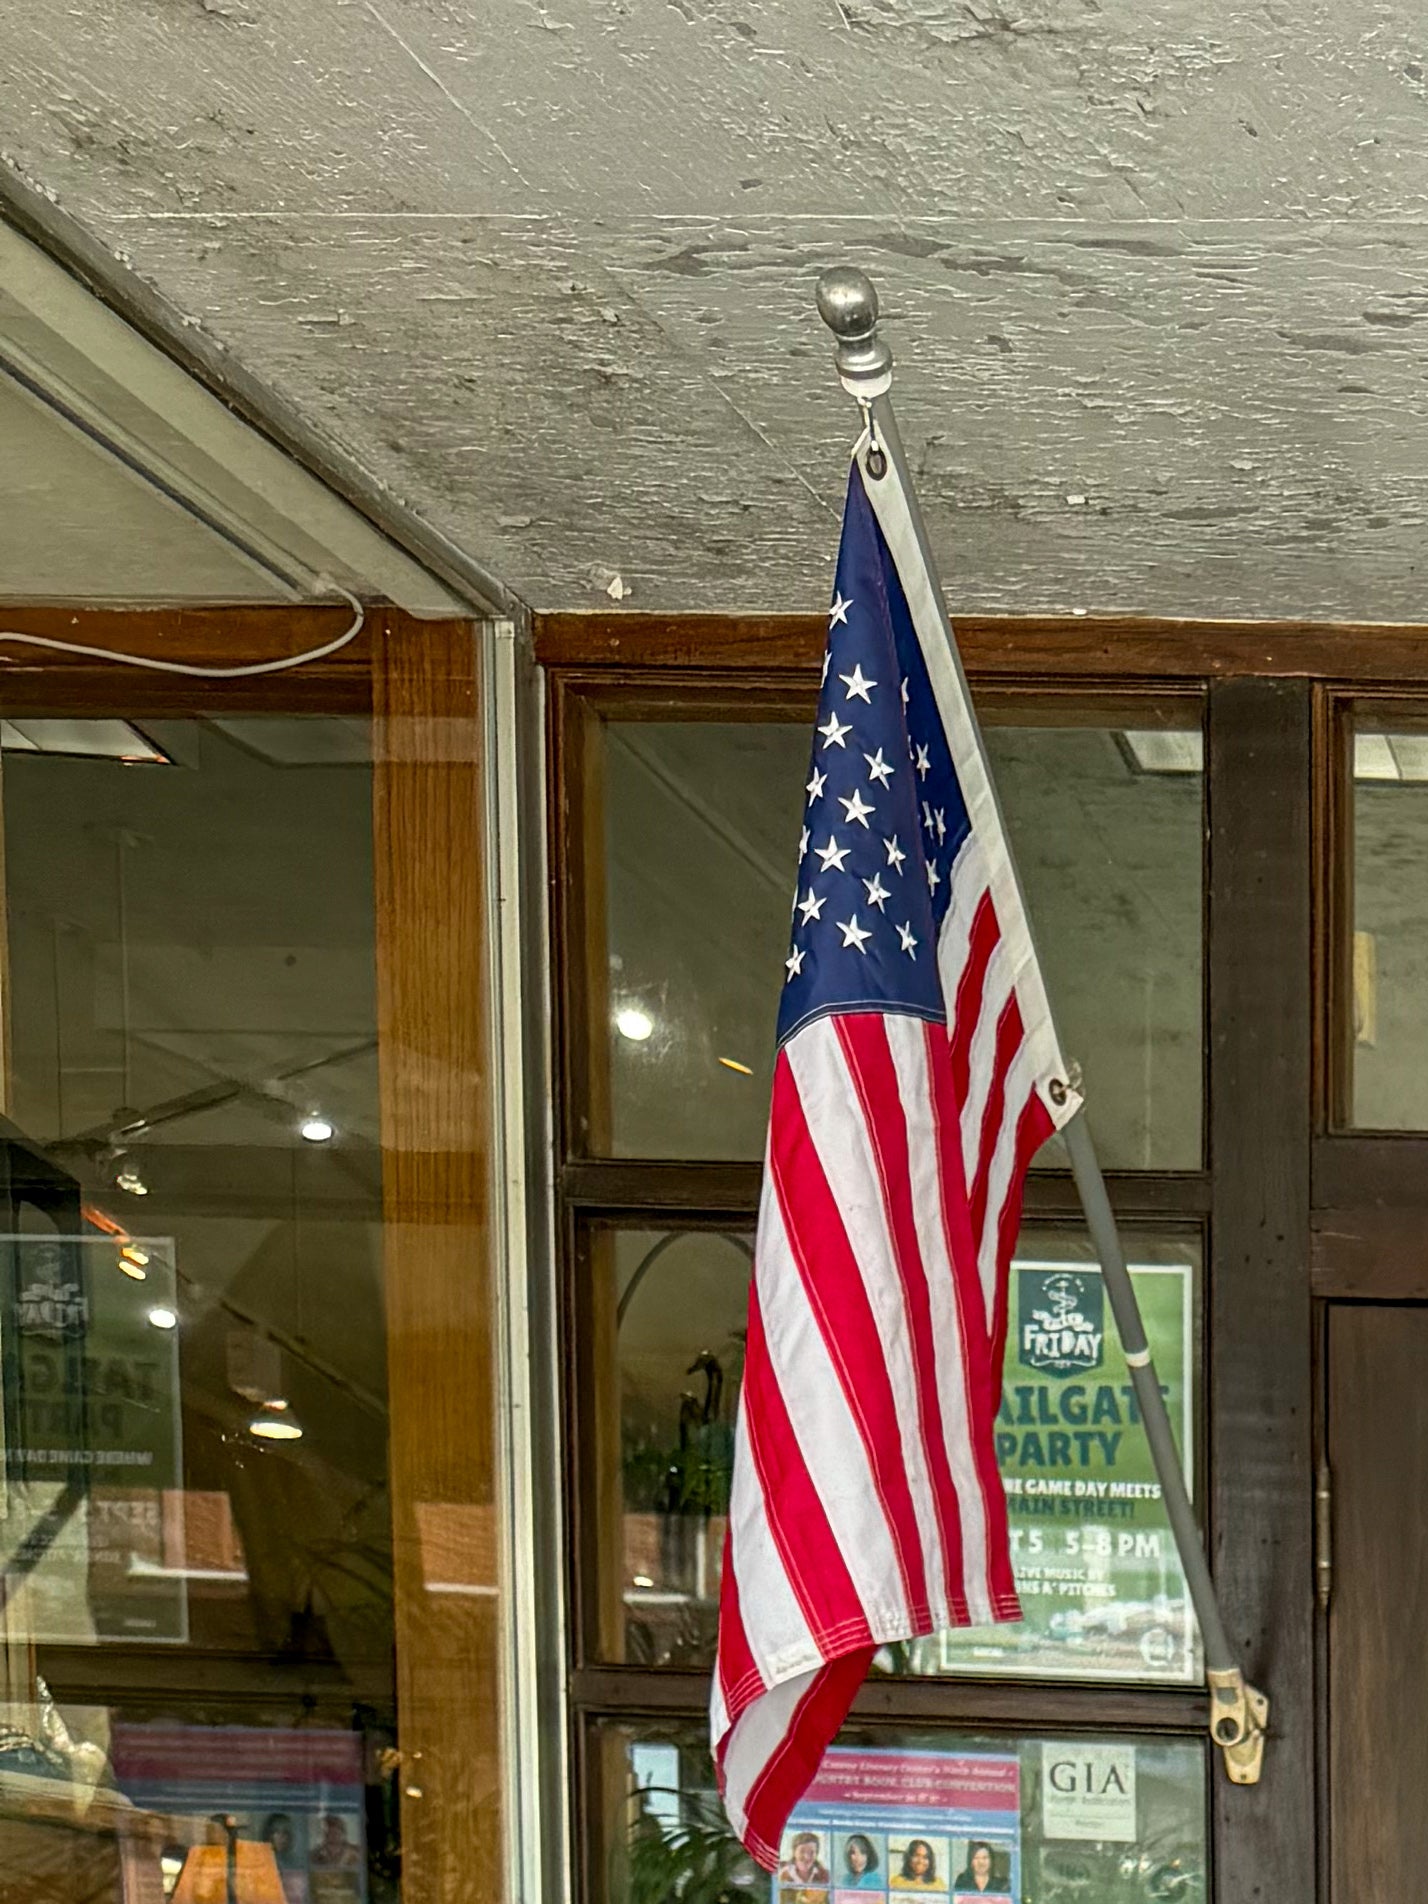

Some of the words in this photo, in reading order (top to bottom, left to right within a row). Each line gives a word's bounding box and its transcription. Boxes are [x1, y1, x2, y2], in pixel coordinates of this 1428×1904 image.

[1024, 1324, 1102, 1358] FRIDAY
[996, 1431, 1122, 1466] PARTY
[1025, 1479, 1073, 1496] GAME
[1075, 1480, 1107, 1498] DAY
[1109, 1482, 1162, 1499] MEETS
[1118, 1533, 1160, 1558] PM
[1049, 1761, 1127, 1795] GIA
